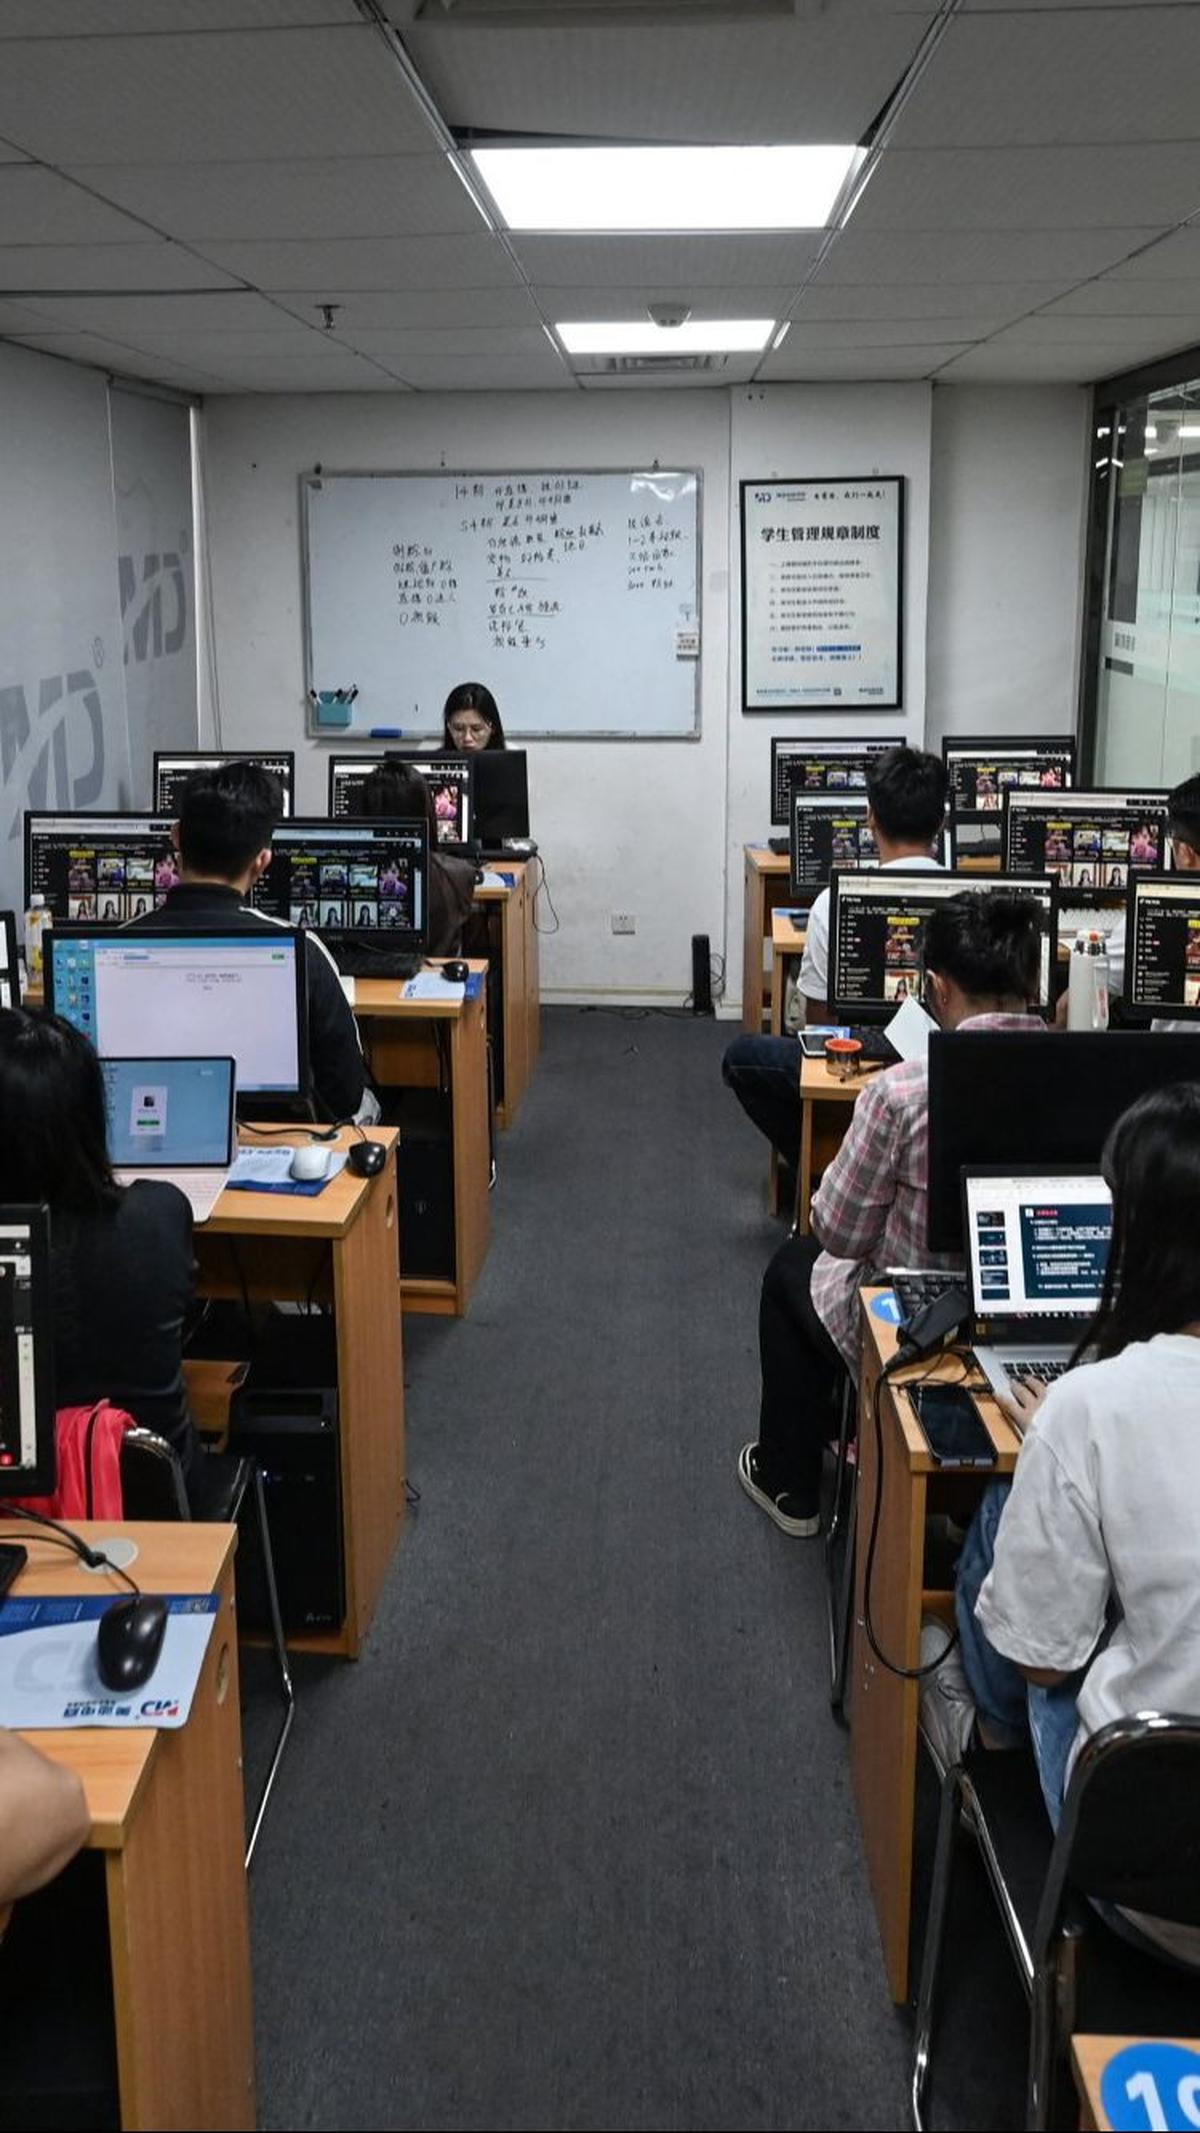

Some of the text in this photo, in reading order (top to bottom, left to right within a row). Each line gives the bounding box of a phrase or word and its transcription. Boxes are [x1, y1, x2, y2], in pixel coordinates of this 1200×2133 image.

[761, 525, 881, 542] 学生管理规章制度
